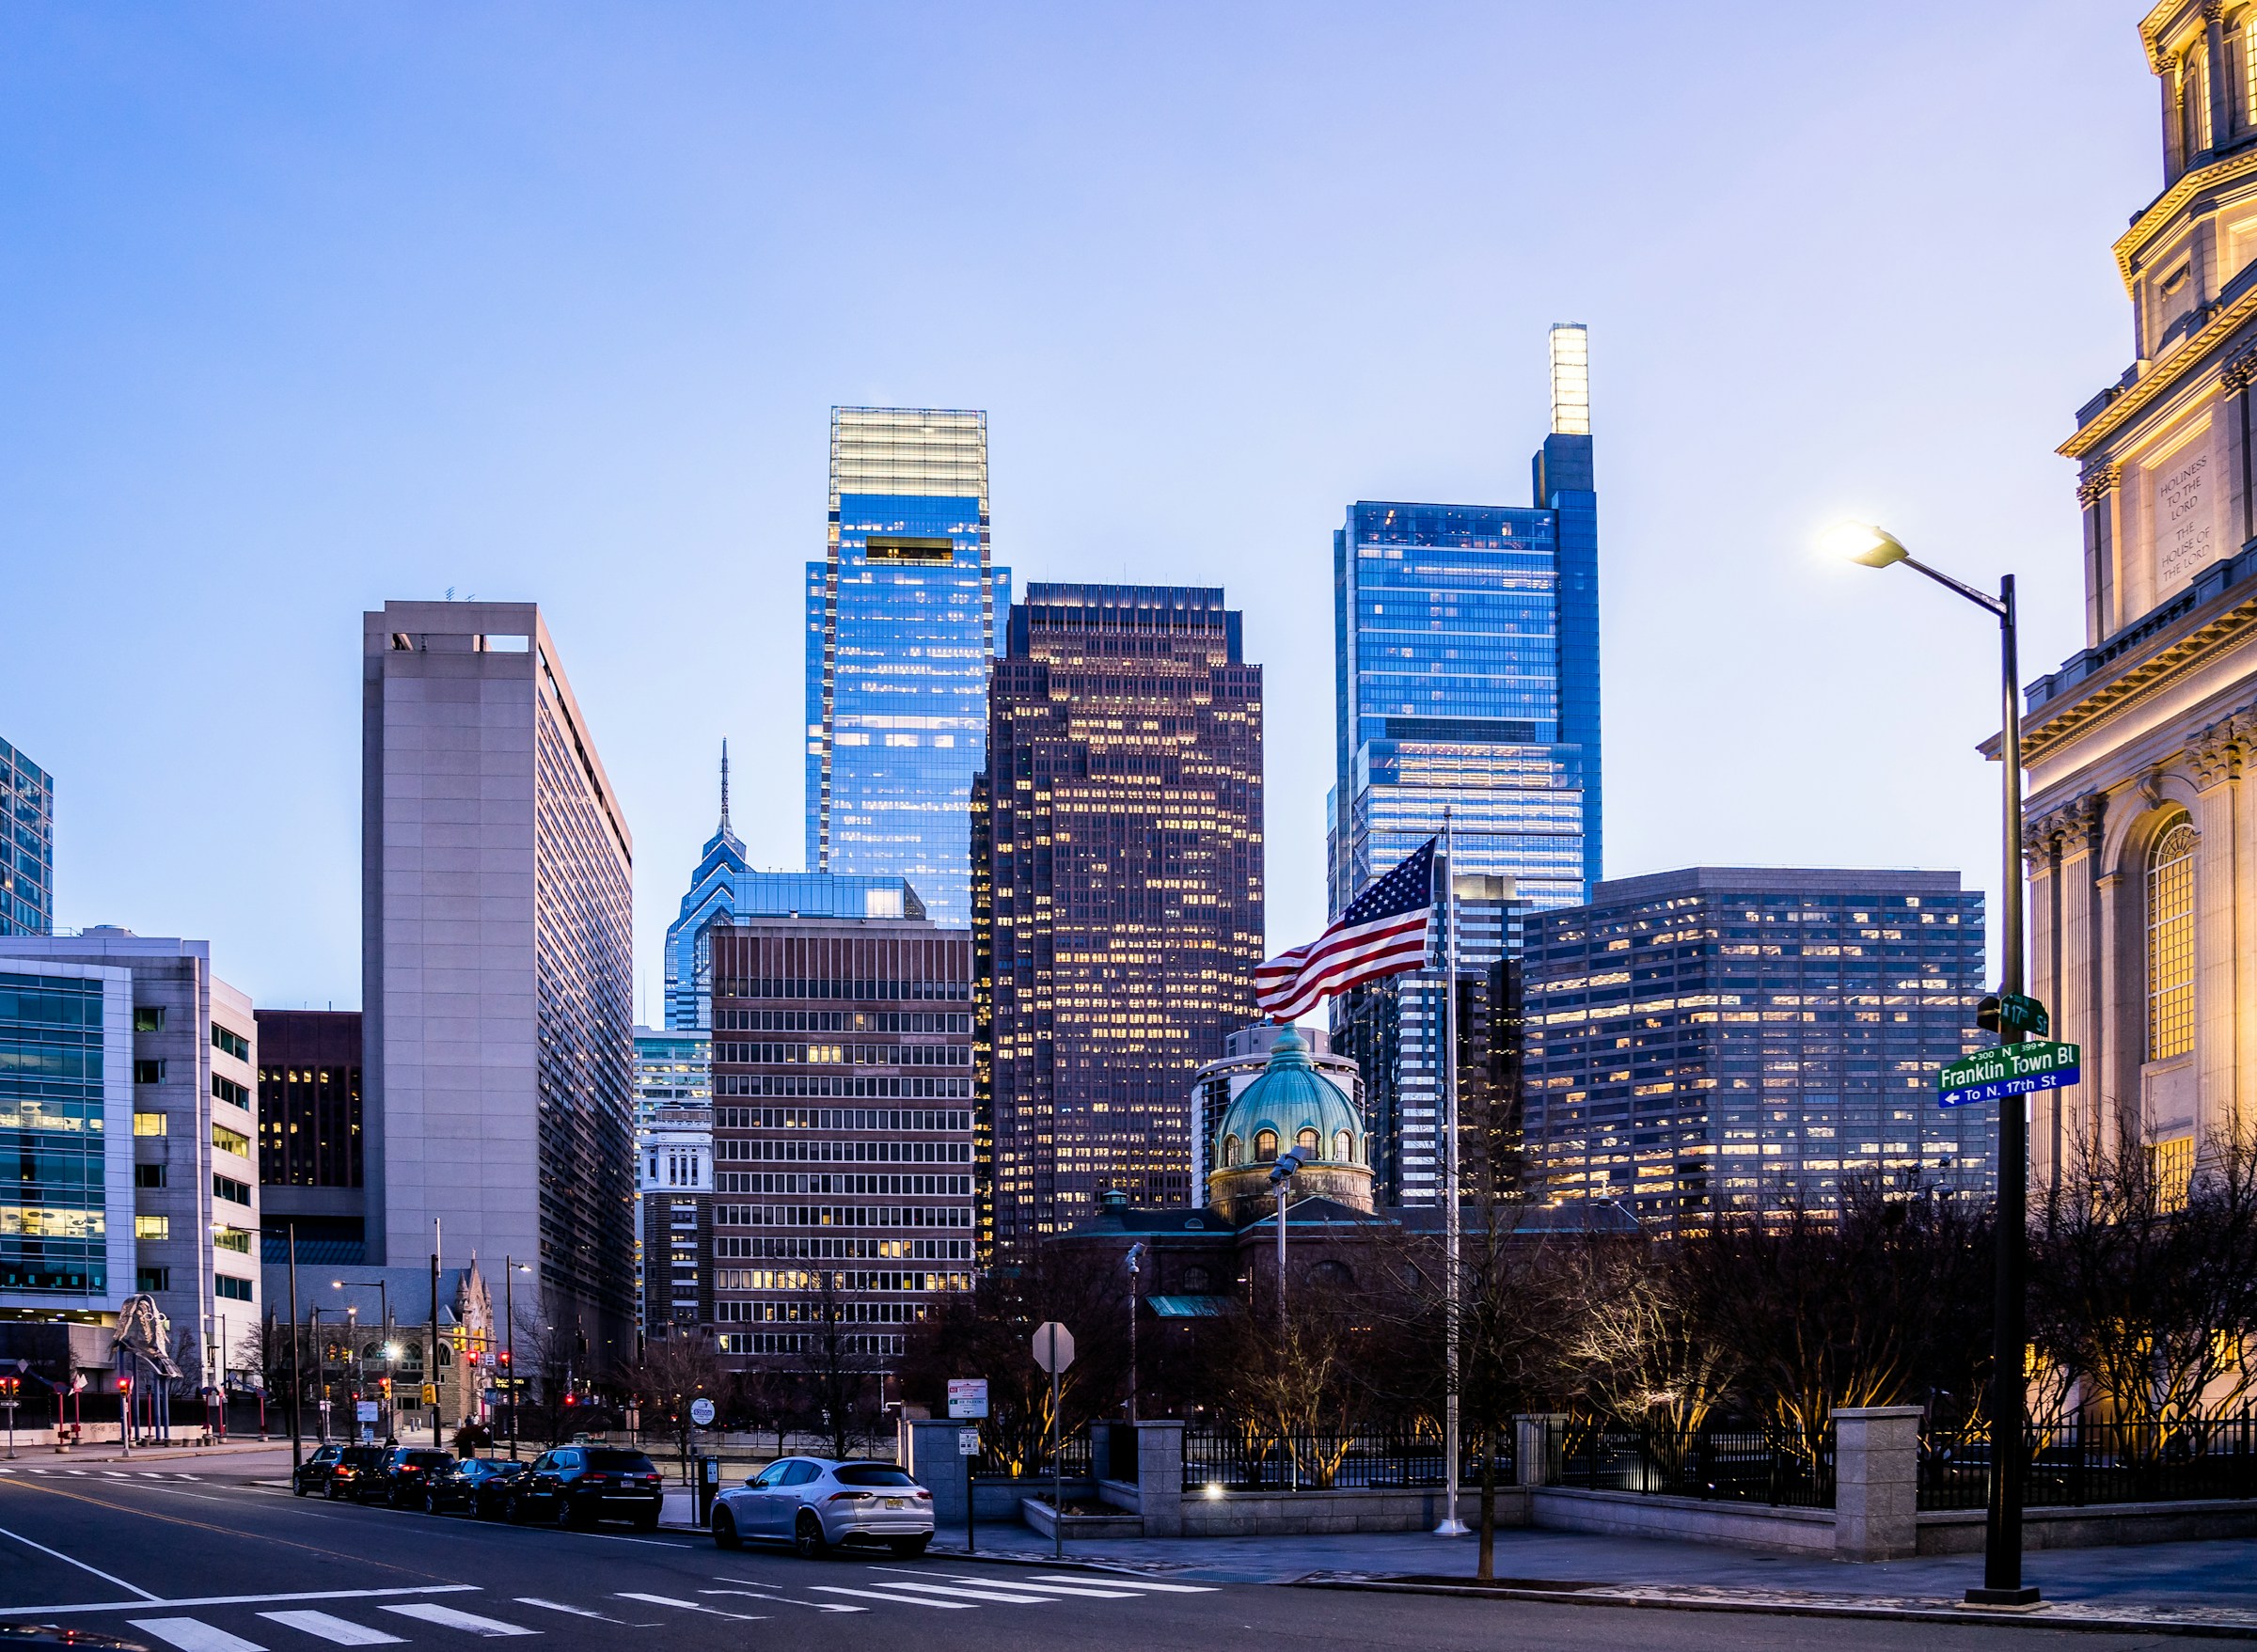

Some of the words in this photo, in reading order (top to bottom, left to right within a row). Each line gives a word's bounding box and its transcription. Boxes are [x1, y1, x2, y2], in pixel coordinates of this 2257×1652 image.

[2160, 455, 2207, 497] HOLINESS
[2166, 491, 2181, 507] TO
[2182, 476, 2202, 496] THE
[2171, 496, 2198, 521] LORD
[2175, 521, 2195, 541] THE
[2161, 538, 2194, 567] HOUSE
[2196, 527, 2211, 543] OF
[2162, 562, 2181, 582] THE
[2184, 544, 2210, 568] LORD
[2036, 1015, 2047, 1034] St
[1977, 1051, 1995, 1061] 300
[2002, 1046, 2012, 1058] N
[2021, 1043, 2037, 1052] 399
[1941, 1060, 2004, 1088] Franklin
[2010, 1052, 2052, 1075] Town
[2058, 1046, 2074, 1065] Bl
[1965, 1089, 1981, 1101] To
[1986, 1085, 2000, 1097] N.
[2006, 1078, 2035, 1093] 17th
[2041, 1076, 2057, 1087] St
